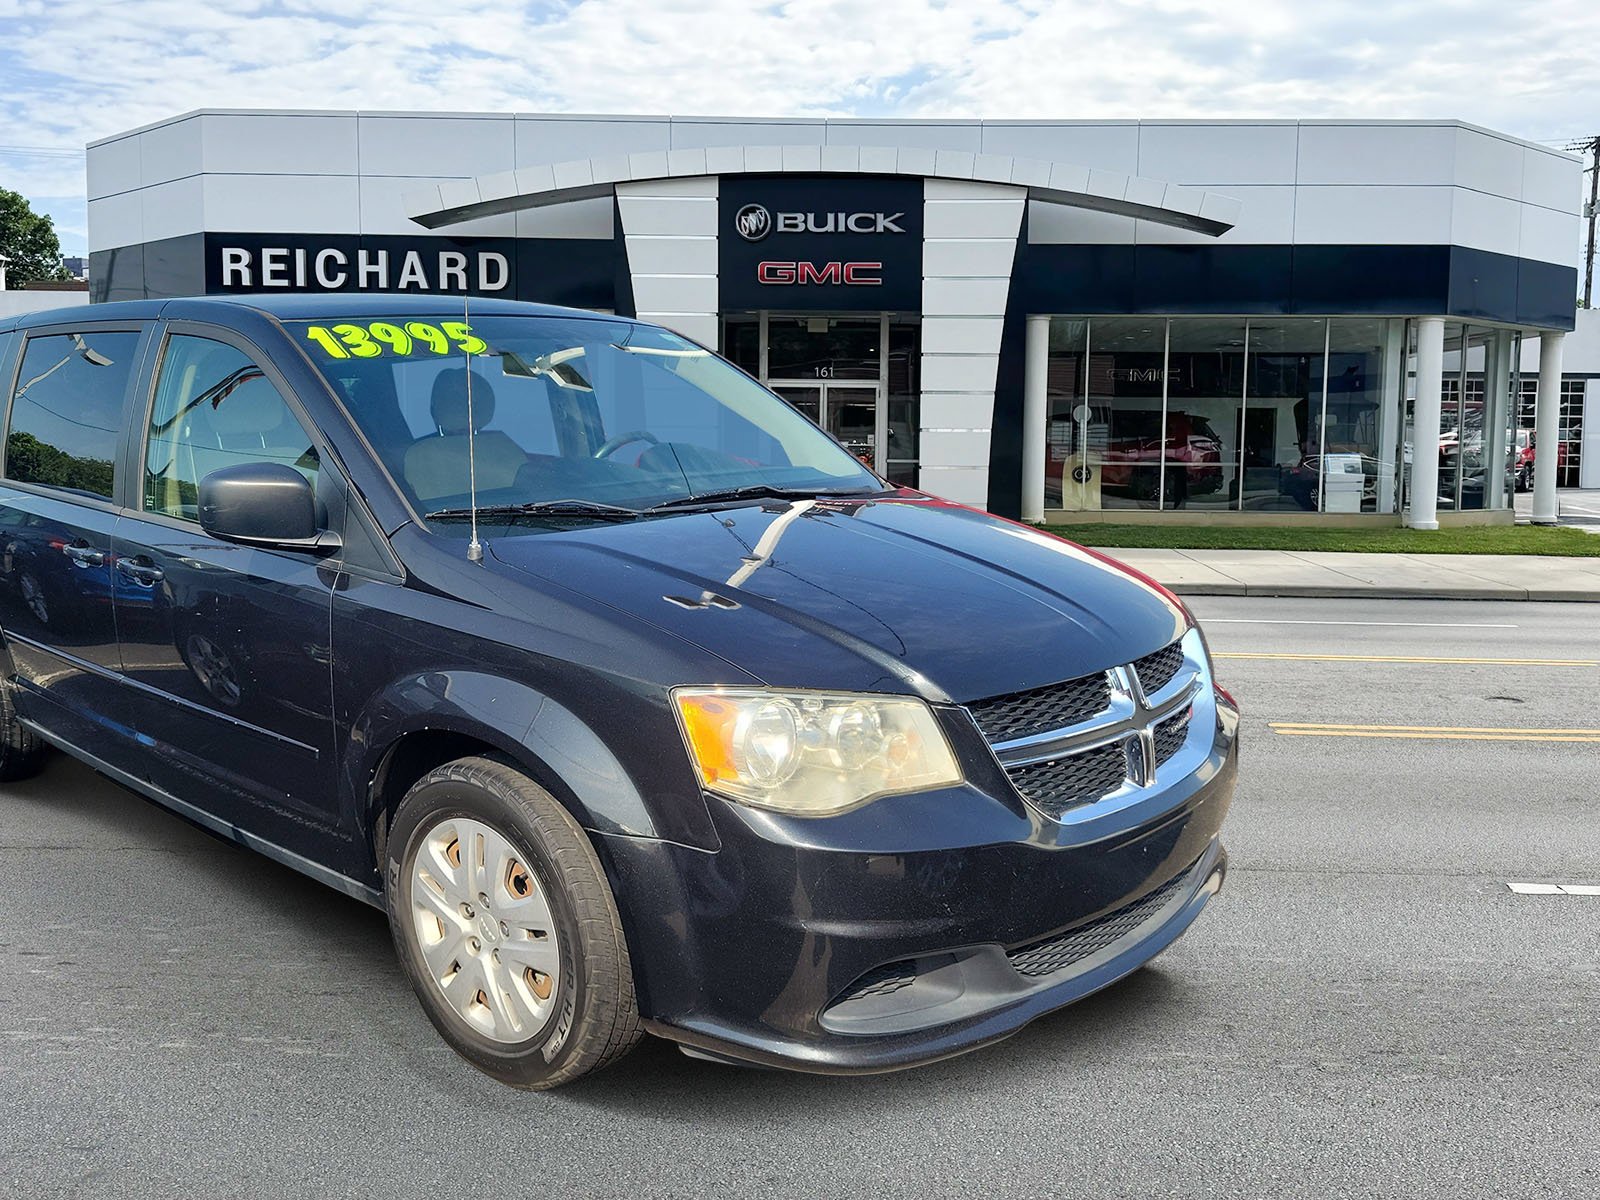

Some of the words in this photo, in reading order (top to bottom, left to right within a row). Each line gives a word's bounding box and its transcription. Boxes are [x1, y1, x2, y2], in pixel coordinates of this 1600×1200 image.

[776, 212, 906, 233] BUICK
[221, 247, 509, 291] REICHARD
[757, 261, 882, 285] GMC
[306, 321, 488, 359] 13995
[814, 366, 835, 378] 161
